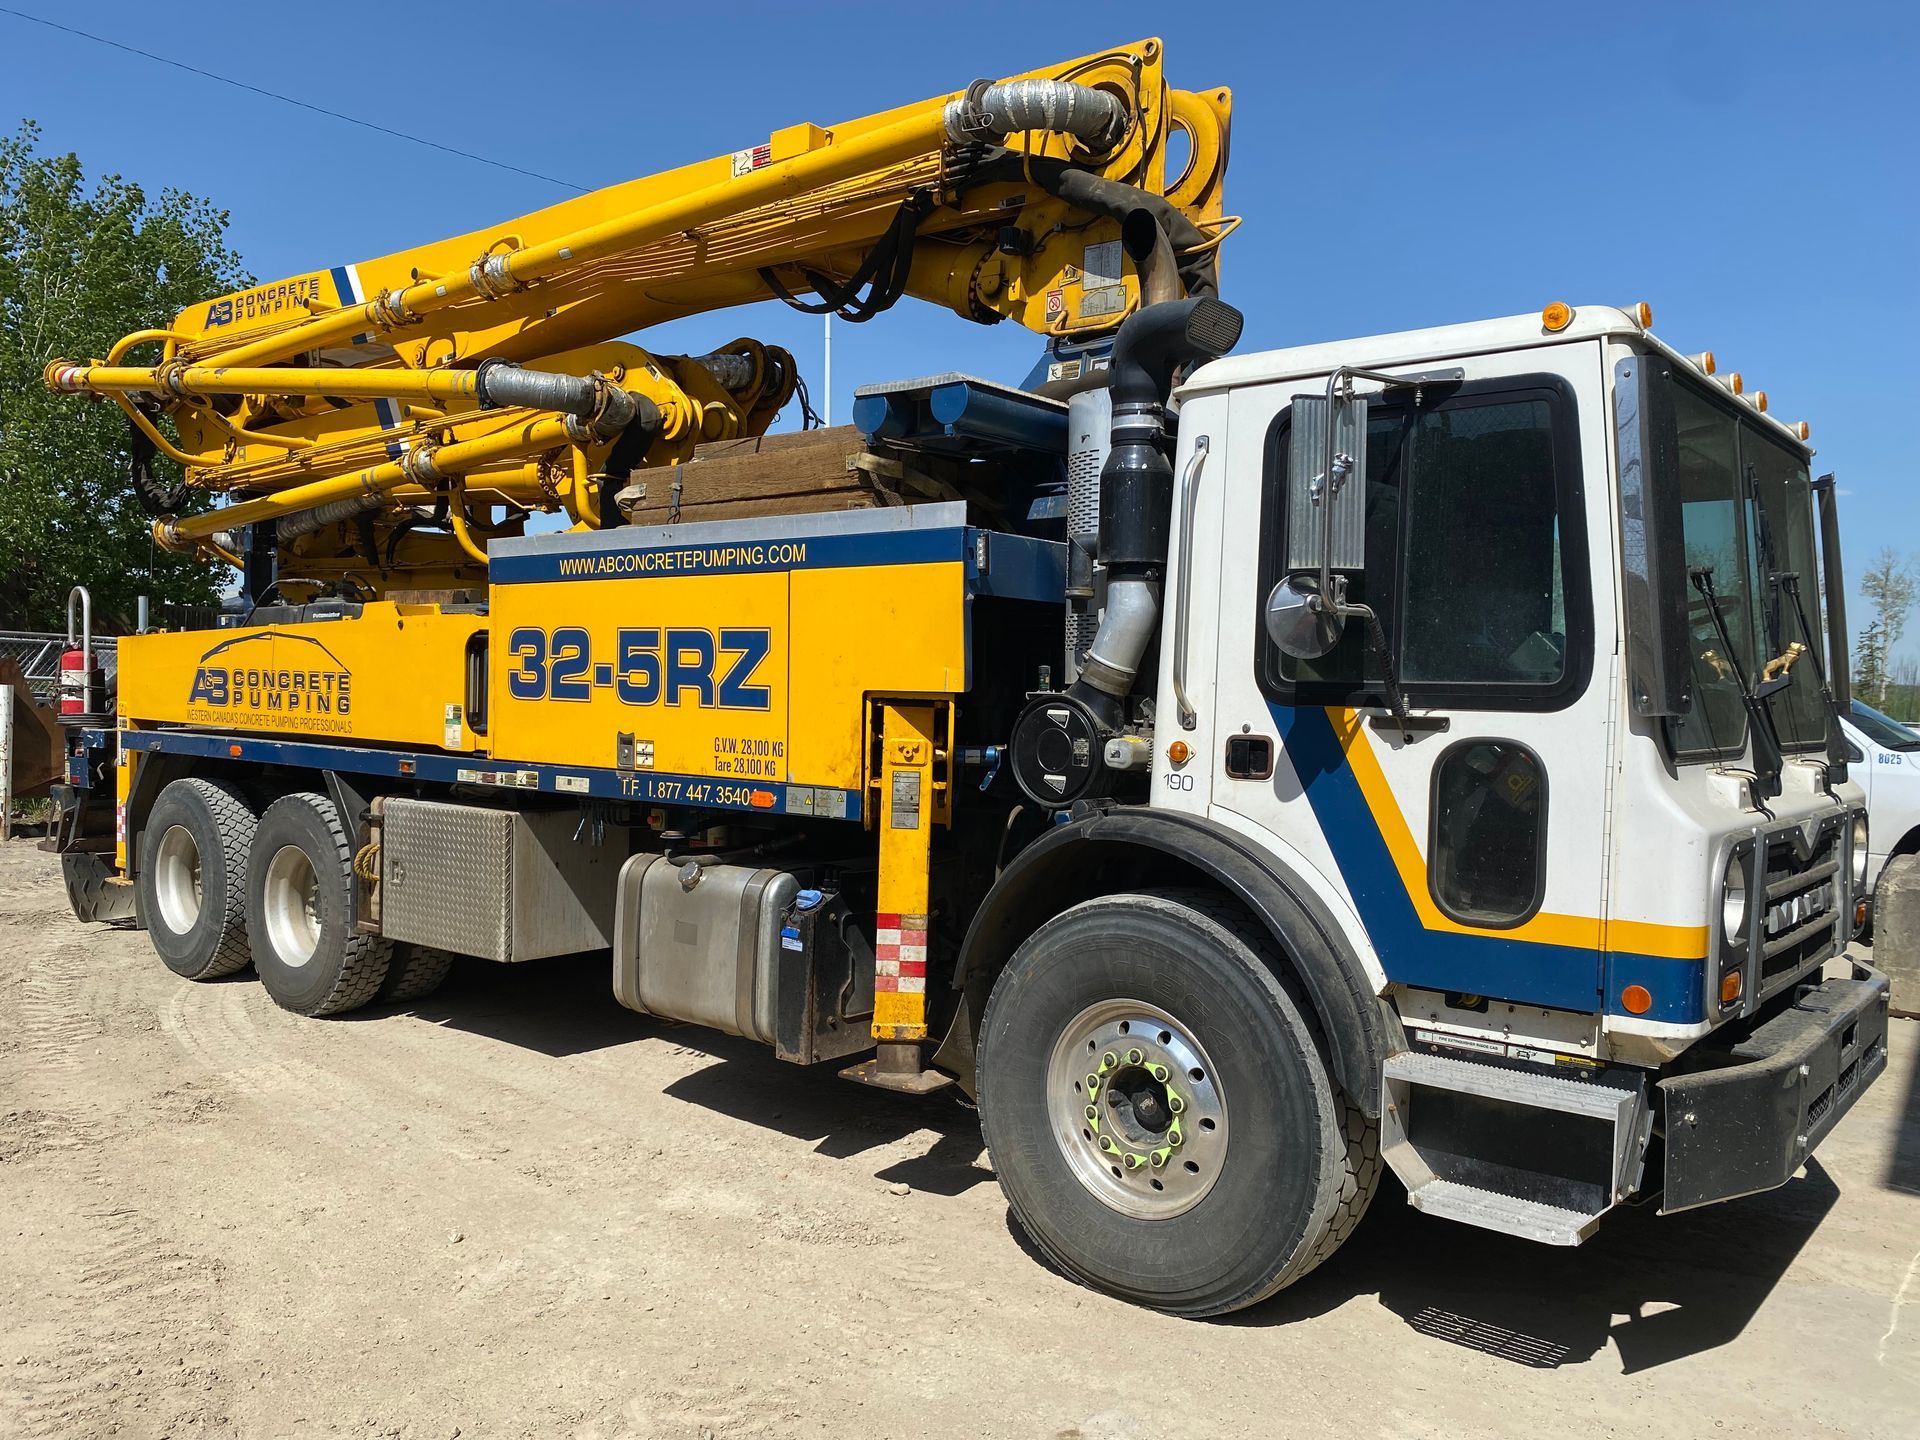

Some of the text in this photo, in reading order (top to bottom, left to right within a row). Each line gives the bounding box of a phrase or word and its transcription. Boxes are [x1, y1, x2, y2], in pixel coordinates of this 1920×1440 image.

[236, 279, 319, 309] CONCRETE
[204, 299, 233, 331] A&B
[559, 543, 807, 576] WWW.ABCONCRETEPUMPING.COM
[232, 669, 351, 693] CONCRETE
[508, 626, 771, 712] 32-5RZ
[187, 666, 229, 707] A&B
[232, 688, 350, 715] PUMPING
[187, 709, 212, 722] WESTERN
[239, 712, 270, 727] CONCRETE
[271, 715, 299, 729] PUMPING
[299, 717, 352, 734] PROFESSIONALS
[714, 736, 784, 758] G.V.W. 28,100 KG
[1878, 752, 1902, 765] 8025
[714, 755, 776, 777] Tare 28,100 KG
[622, 779, 642, 796] T.F.
[1163, 773, 1194, 791] 190
